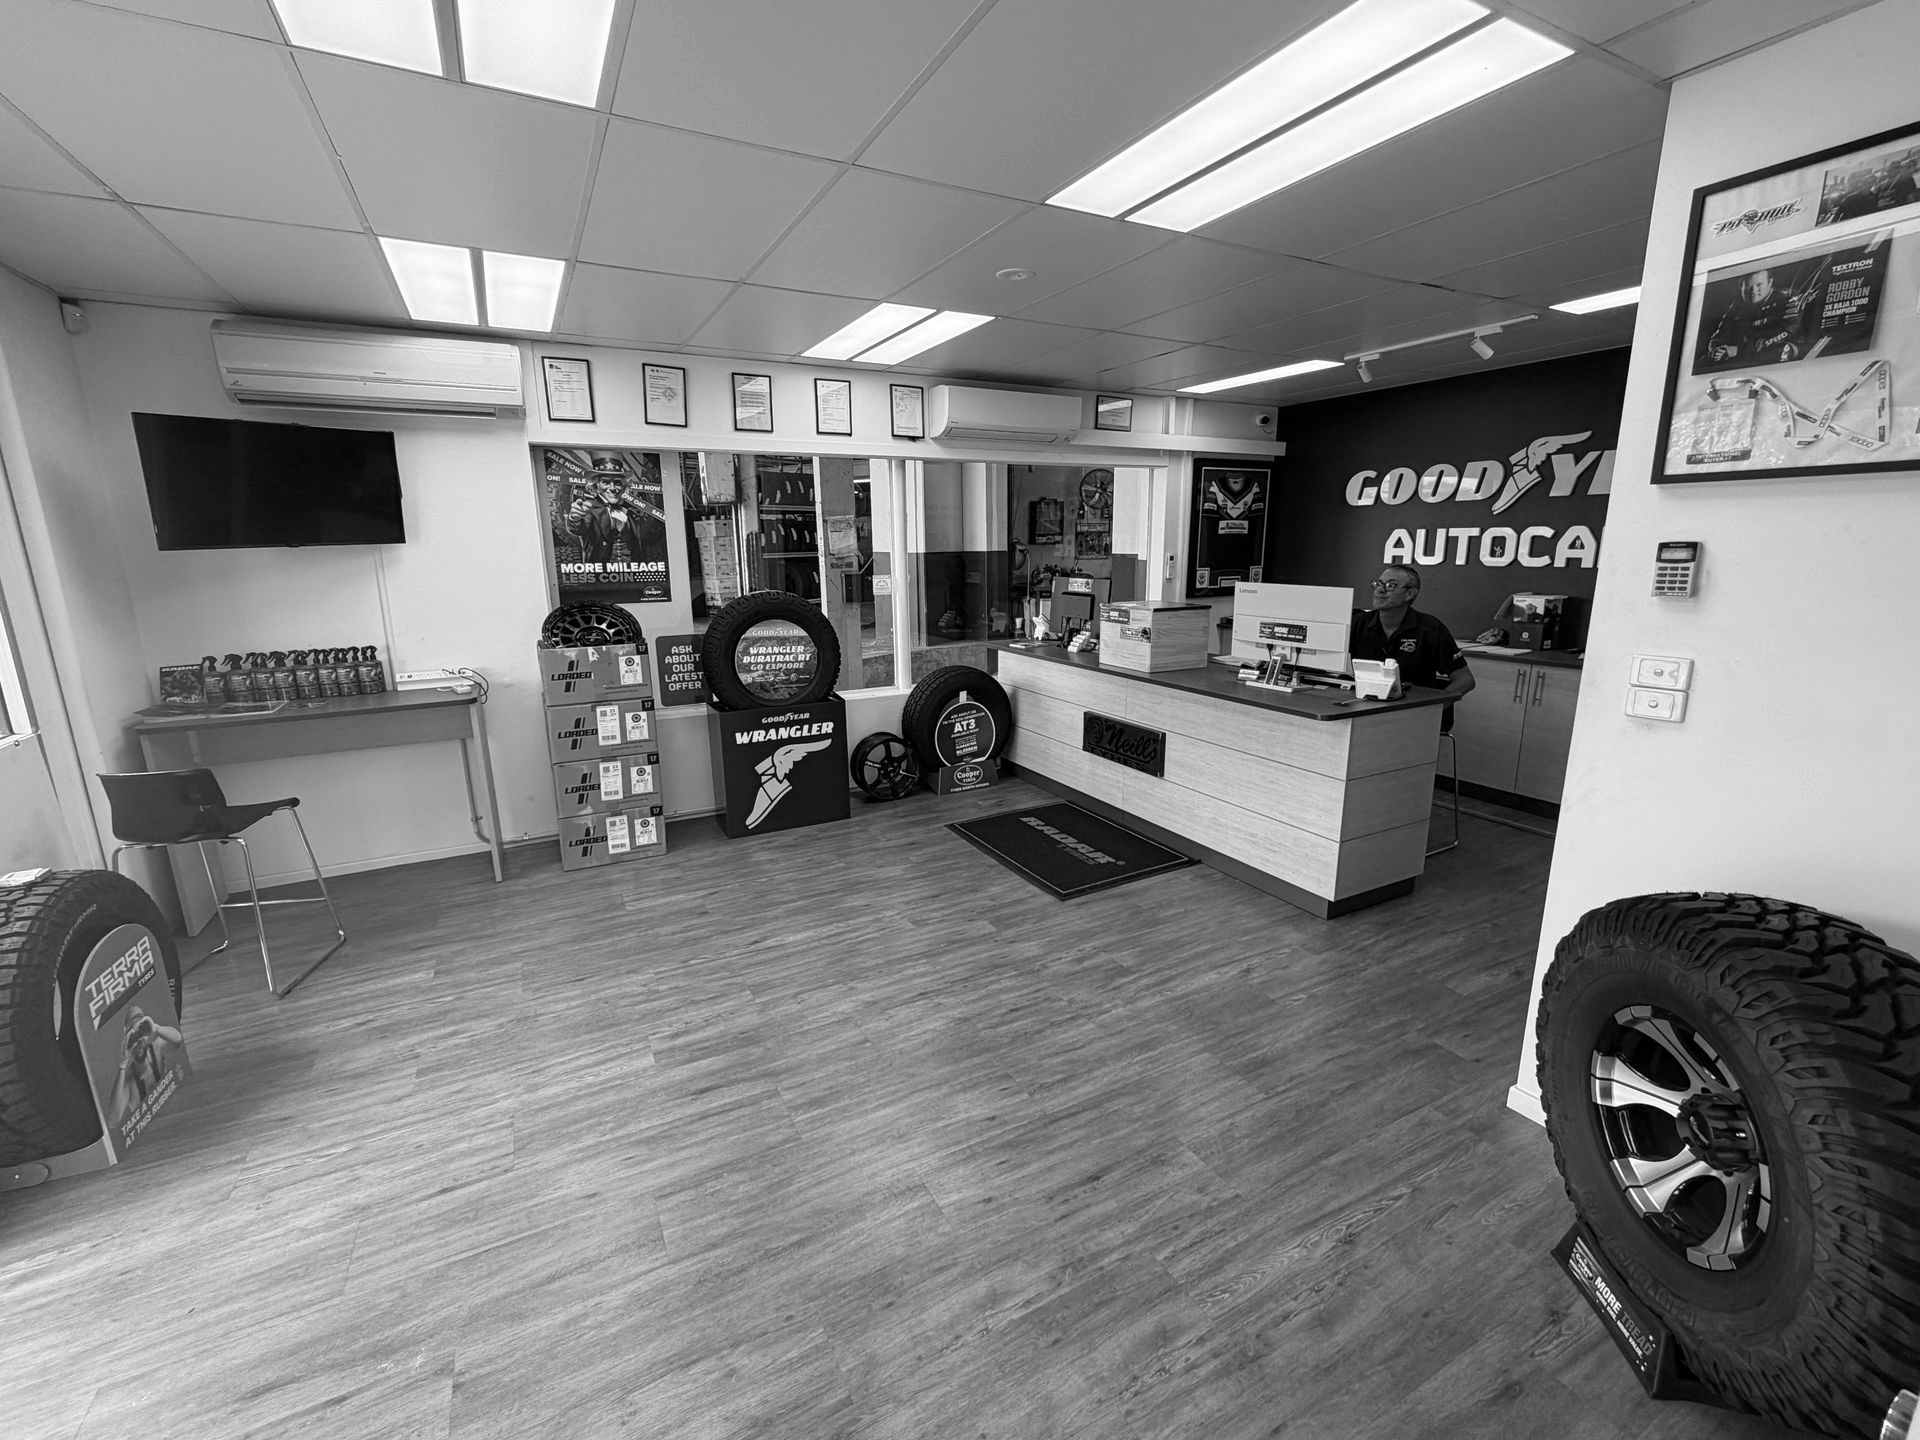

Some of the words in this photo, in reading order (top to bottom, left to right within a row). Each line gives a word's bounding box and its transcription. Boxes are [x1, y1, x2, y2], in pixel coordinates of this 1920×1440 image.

[1832, 258, 1874, 272] TEXTRON
[1828, 277, 1865, 293] ROBBY
[1826, 286, 1871, 303] GORDON
[1824, 303, 1833, 311] 3X
[1833, 301, 1850, 310] BAJA
[1851, 297, 1869, 306] 1000
[1822, 306, 1857, 318] CHAMPION
[546, 451, 564, 464] SALE
[564, 461, 582, 474] NOW
[1345, 449, 1617, 507] GOODY
[622, 493, 634, 502] OW
[633, 498, 647, 509] ON!
[1383, 525, 1607, 569] AUTOCA
[561, 562, 604, 574] MORE
[606, 561, 666, 573] MILEAGE
[562, 573, 597, 584] LESS
[599, 572, 636, 583] COIN
[752, 628, 800, 636] GOODYEAR
[671, 645, 693, 654] ASK
[749, 645, 805, 655] WRANGLER
[665, 653, 701, 664] ABOUT
[742, 654, 796, 664] DURATRAC
[797, 653, 812, 661] RT
[672, 663, 695, 672] OUR
[750, 663, 764, 671] GO
[765, 662, 805, 670] EXPLORE
[551, 671, 592, 682] LOADED
[665, 671, 704, 682] LATEST
[668, 682, 702, 691] OFFER
[761, 712, 810, 724] GOODYEAR
[953, 718, 976, 733] AT3
[557, 728, 598, 739] LOADED
[735, 721, 835, 745] WRANGLER
[956, 769, 981, 779] Cooper
[568, 836, 608, 848] LOADED
[1018, 816, 1117, 864] RADAR
[85, 935, 151, 998] TERRA
[88, 950, 154, 1020] FIRMA
[137, 968, 155, 988] TYRES
[121, 1110, 141, 1137] TAKE
[140, 1102, 148, 1114] A
[147, 1069, 174, 1104] GANDER
[125, 1134, 135, 1149] AT
[135, 1113, 152, 1137] THIS
[1594, 1276, 1622, 1315] MORE
[1621, 1310, 1654, 1356] TREAD
[1595, 1289, 1608, 1308] MORE
[1616, 1319, 1630, 1339] MORE
